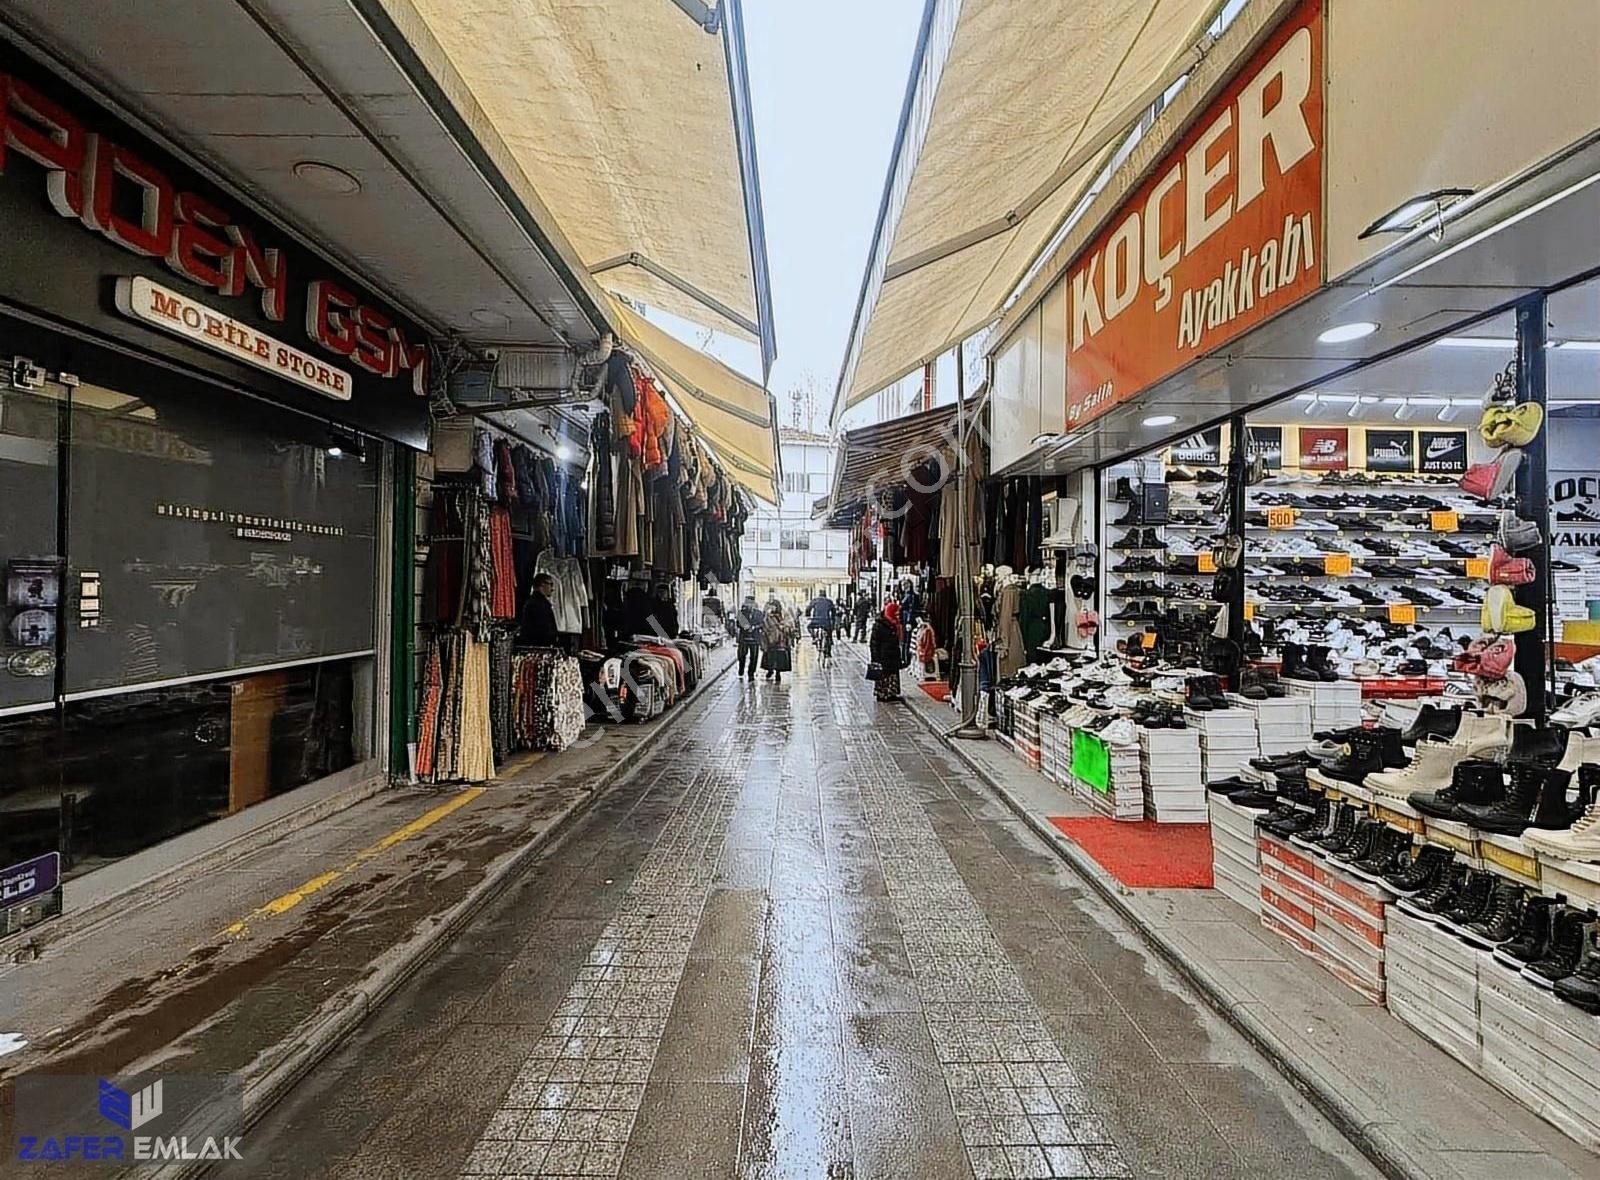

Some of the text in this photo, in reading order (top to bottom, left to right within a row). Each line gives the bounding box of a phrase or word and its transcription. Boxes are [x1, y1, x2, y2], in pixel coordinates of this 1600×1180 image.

[1071, 27, 1315, 353] KOÇER
[1178, 213, 1313, 349] Ayakkabı
[306, 279, 429, 396] GSM
[277, 347, 344, 392] STORE
[1178, 453, 1216, 461] adidas
[1374, 448, 1400, 458] PUMA
[1430, 437, 1457, 449] NIKE
[1269, 513, 1290, 526] 500
